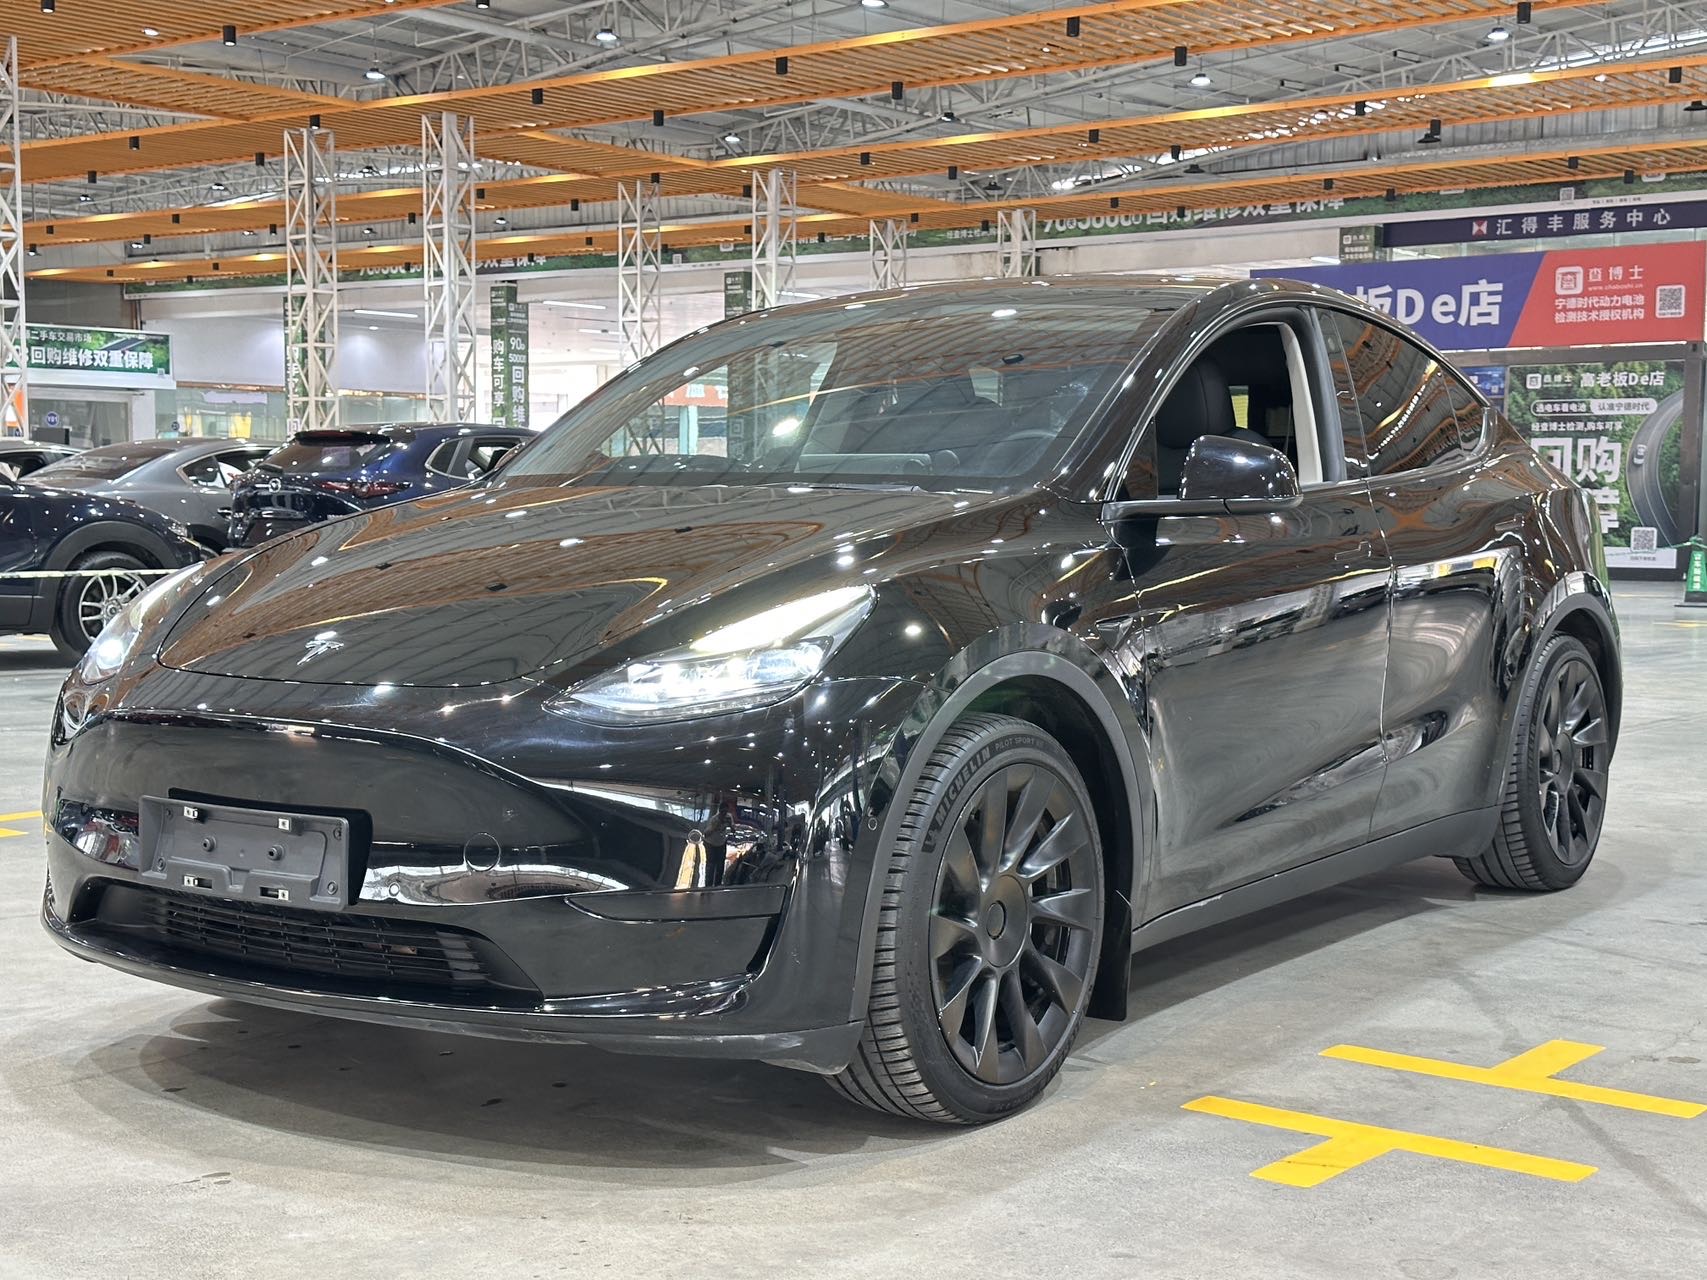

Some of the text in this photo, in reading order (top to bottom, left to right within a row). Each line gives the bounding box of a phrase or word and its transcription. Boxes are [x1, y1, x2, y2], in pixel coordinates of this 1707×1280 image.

[1496, 208, 1671, 235] 汇得丰服务中心
[1588, 265, 1644, 282] 查博士
[1555, 294, 1645, 310] 宁德时代动力电池
[1555, 308, 1645, 324] 检测技术授权机构
[31, 346, 154, 370] 回购维修双重保障
[1580, 370, 1665, 388] 高老板De店
[1598, 402, 1650, 412] 认准宁德时代
[935, 746, 991, 827] MICHELIN
[995, 737, 1013, 751] PILOT
[1015, 736, 1035, 746] SPORT
